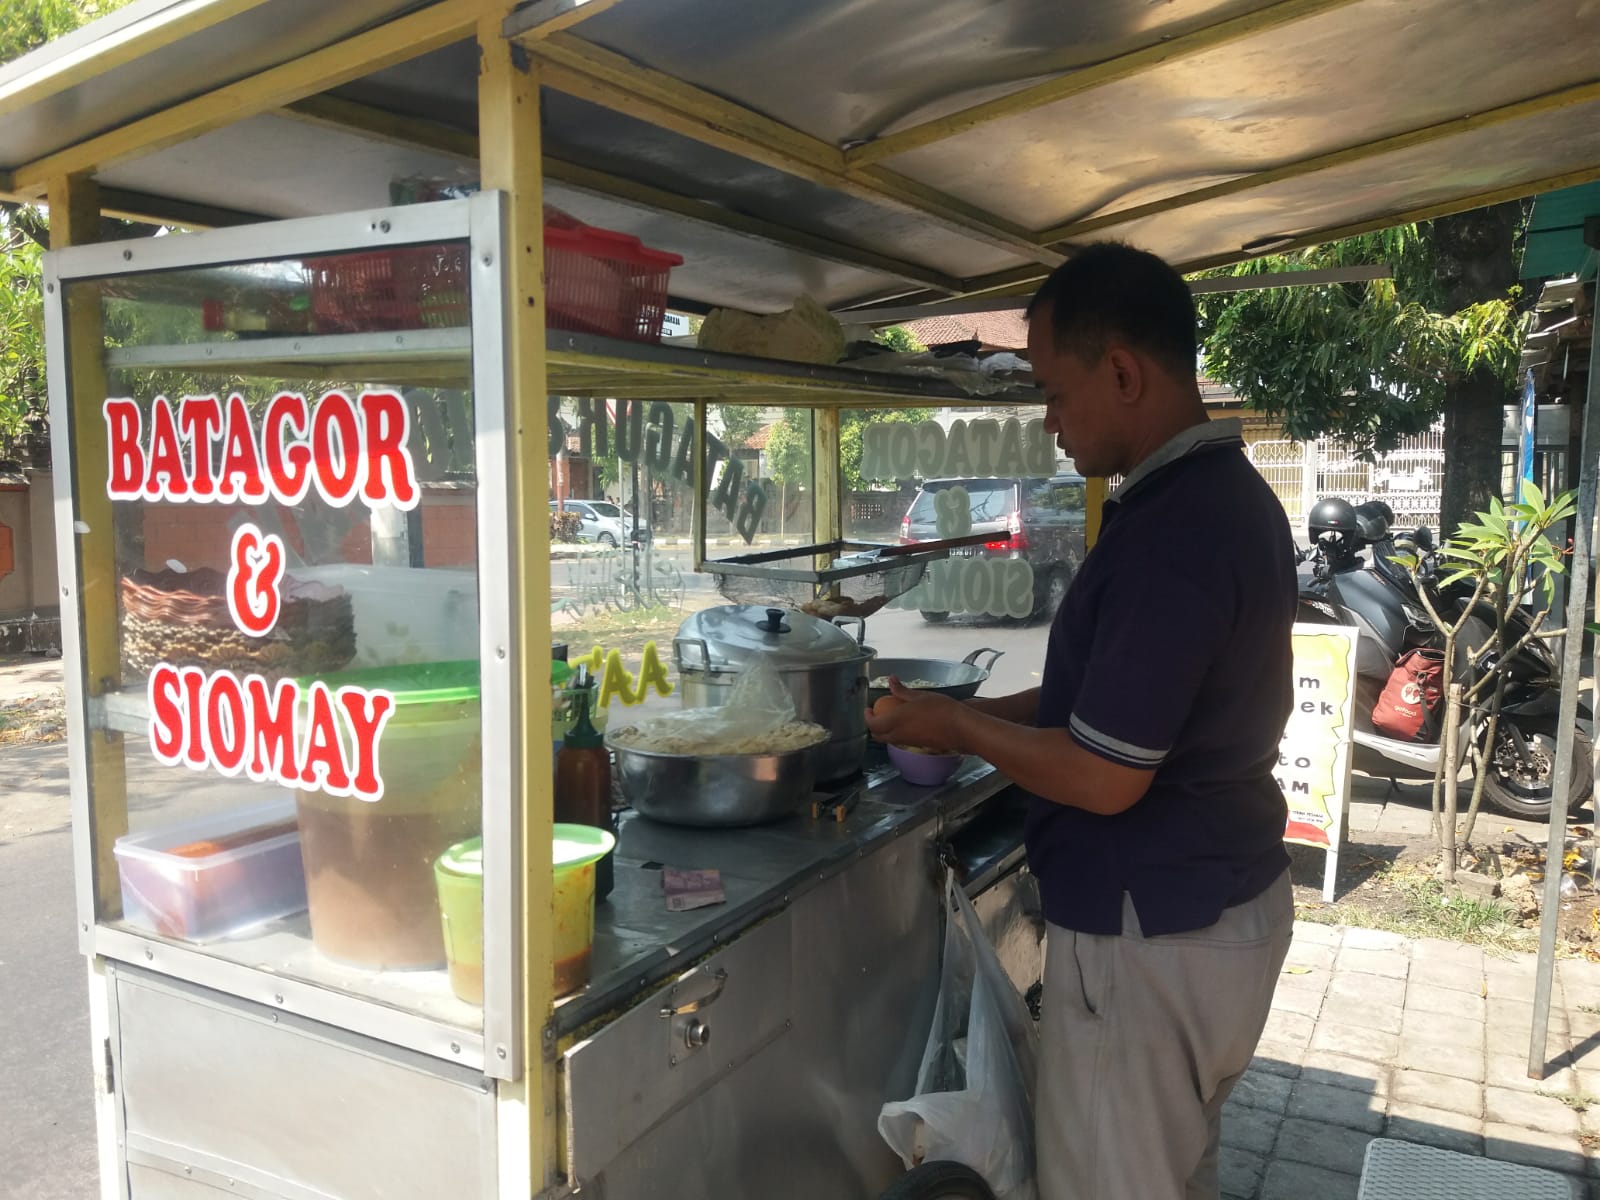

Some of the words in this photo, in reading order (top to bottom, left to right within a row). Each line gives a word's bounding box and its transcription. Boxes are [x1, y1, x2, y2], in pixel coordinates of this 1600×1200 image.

[105, 390, 419, 507] BATAGOR
[228, 524, 284, 635] &
[149, 664, 393, 800] SIOMAY
